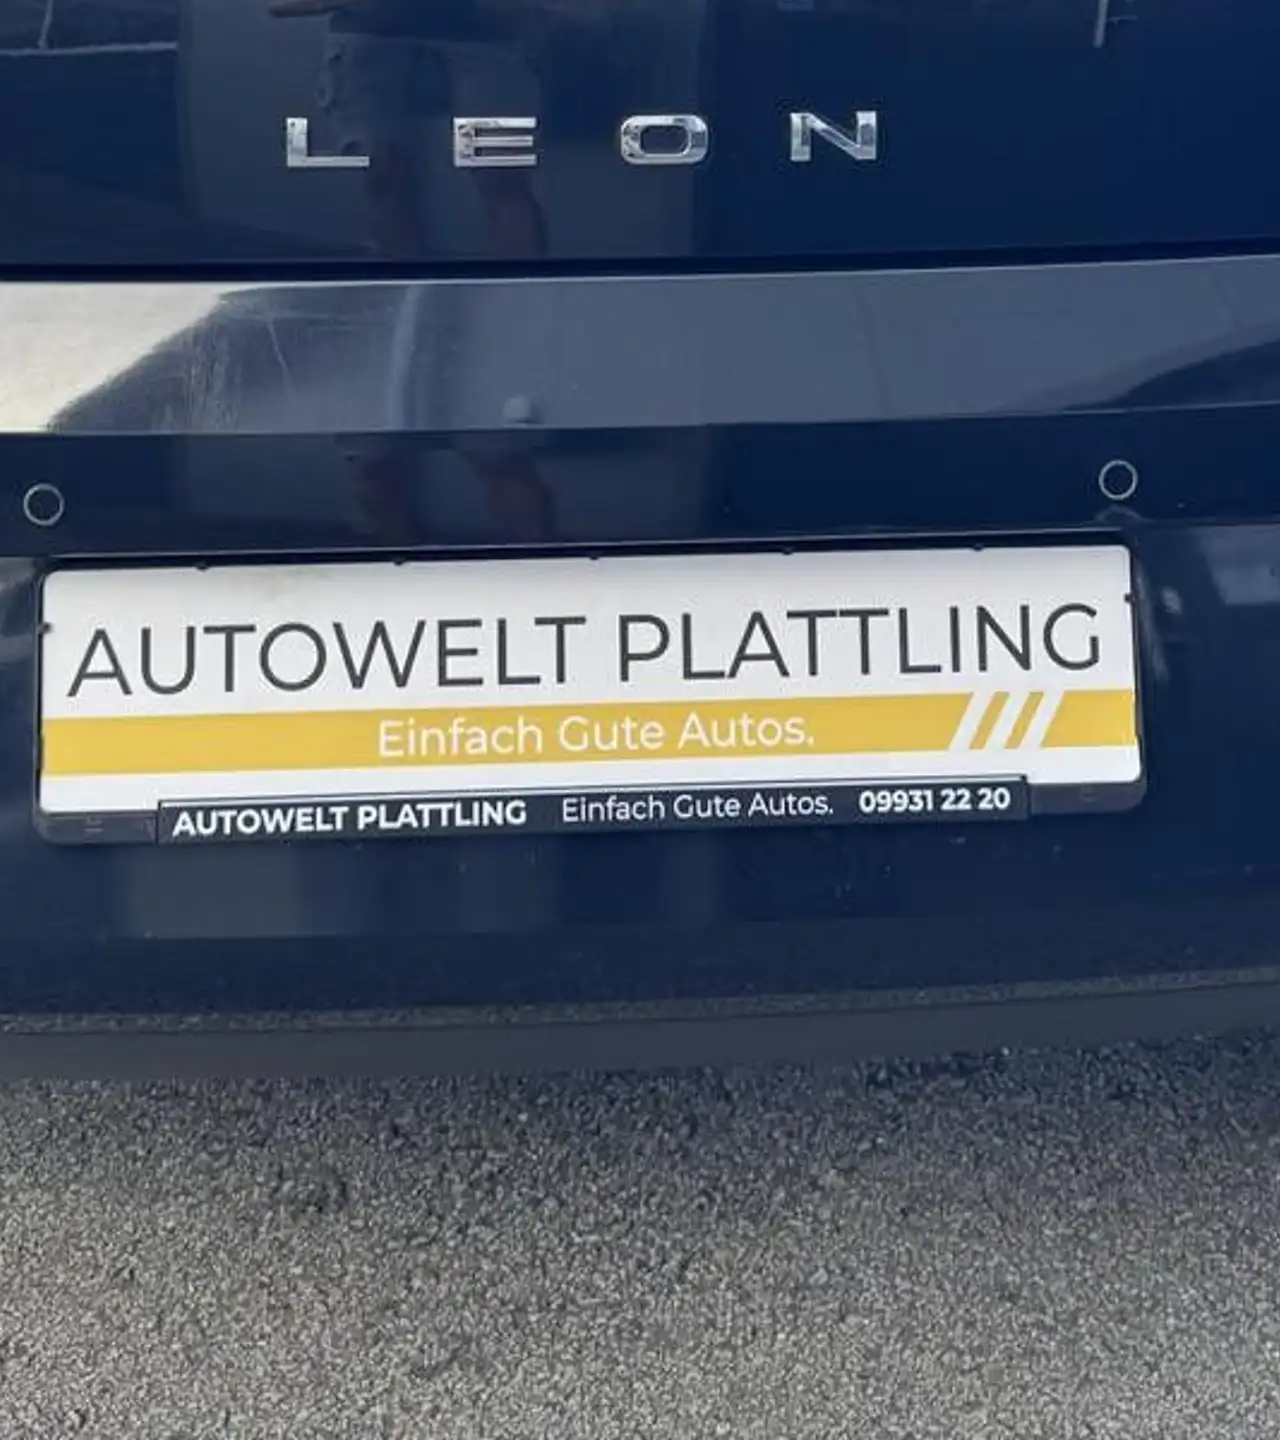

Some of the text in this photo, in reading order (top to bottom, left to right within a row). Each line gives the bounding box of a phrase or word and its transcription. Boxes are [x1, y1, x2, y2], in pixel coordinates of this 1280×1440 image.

[285, 110, 878, 168] LEON
[66, 602, 1100, 697] AUTOWELT PLATTLING
[378, 710, 816, 758] Einfach Gute Autos.
[172, 787, 1011, 837] AUTOWELT PLATTLING Einfach Gute Autos. 09931 22 20
